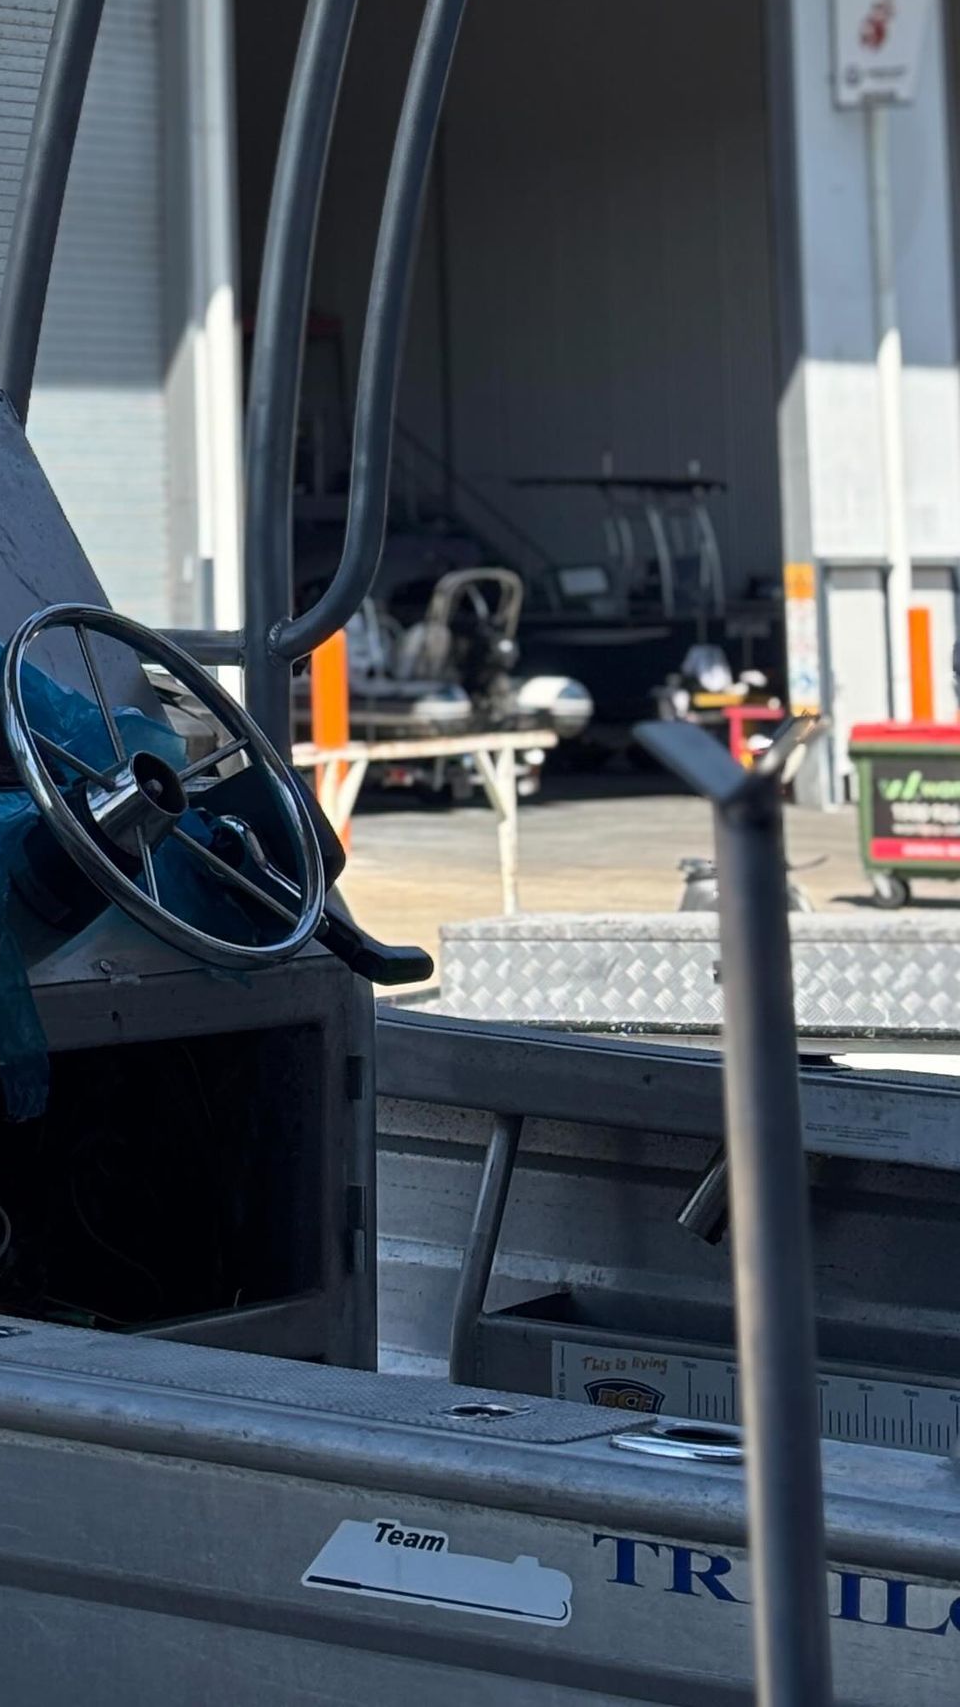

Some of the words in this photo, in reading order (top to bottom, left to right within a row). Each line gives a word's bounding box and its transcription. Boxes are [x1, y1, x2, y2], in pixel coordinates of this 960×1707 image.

[581, 1356, 611, 1372] This
[615, 1357, 627, 1372] is
[632, 1355, 669, 1375] living
[374, 1522, 446, 1552] Team
[593, 1533, 960, 1637] TRIL
